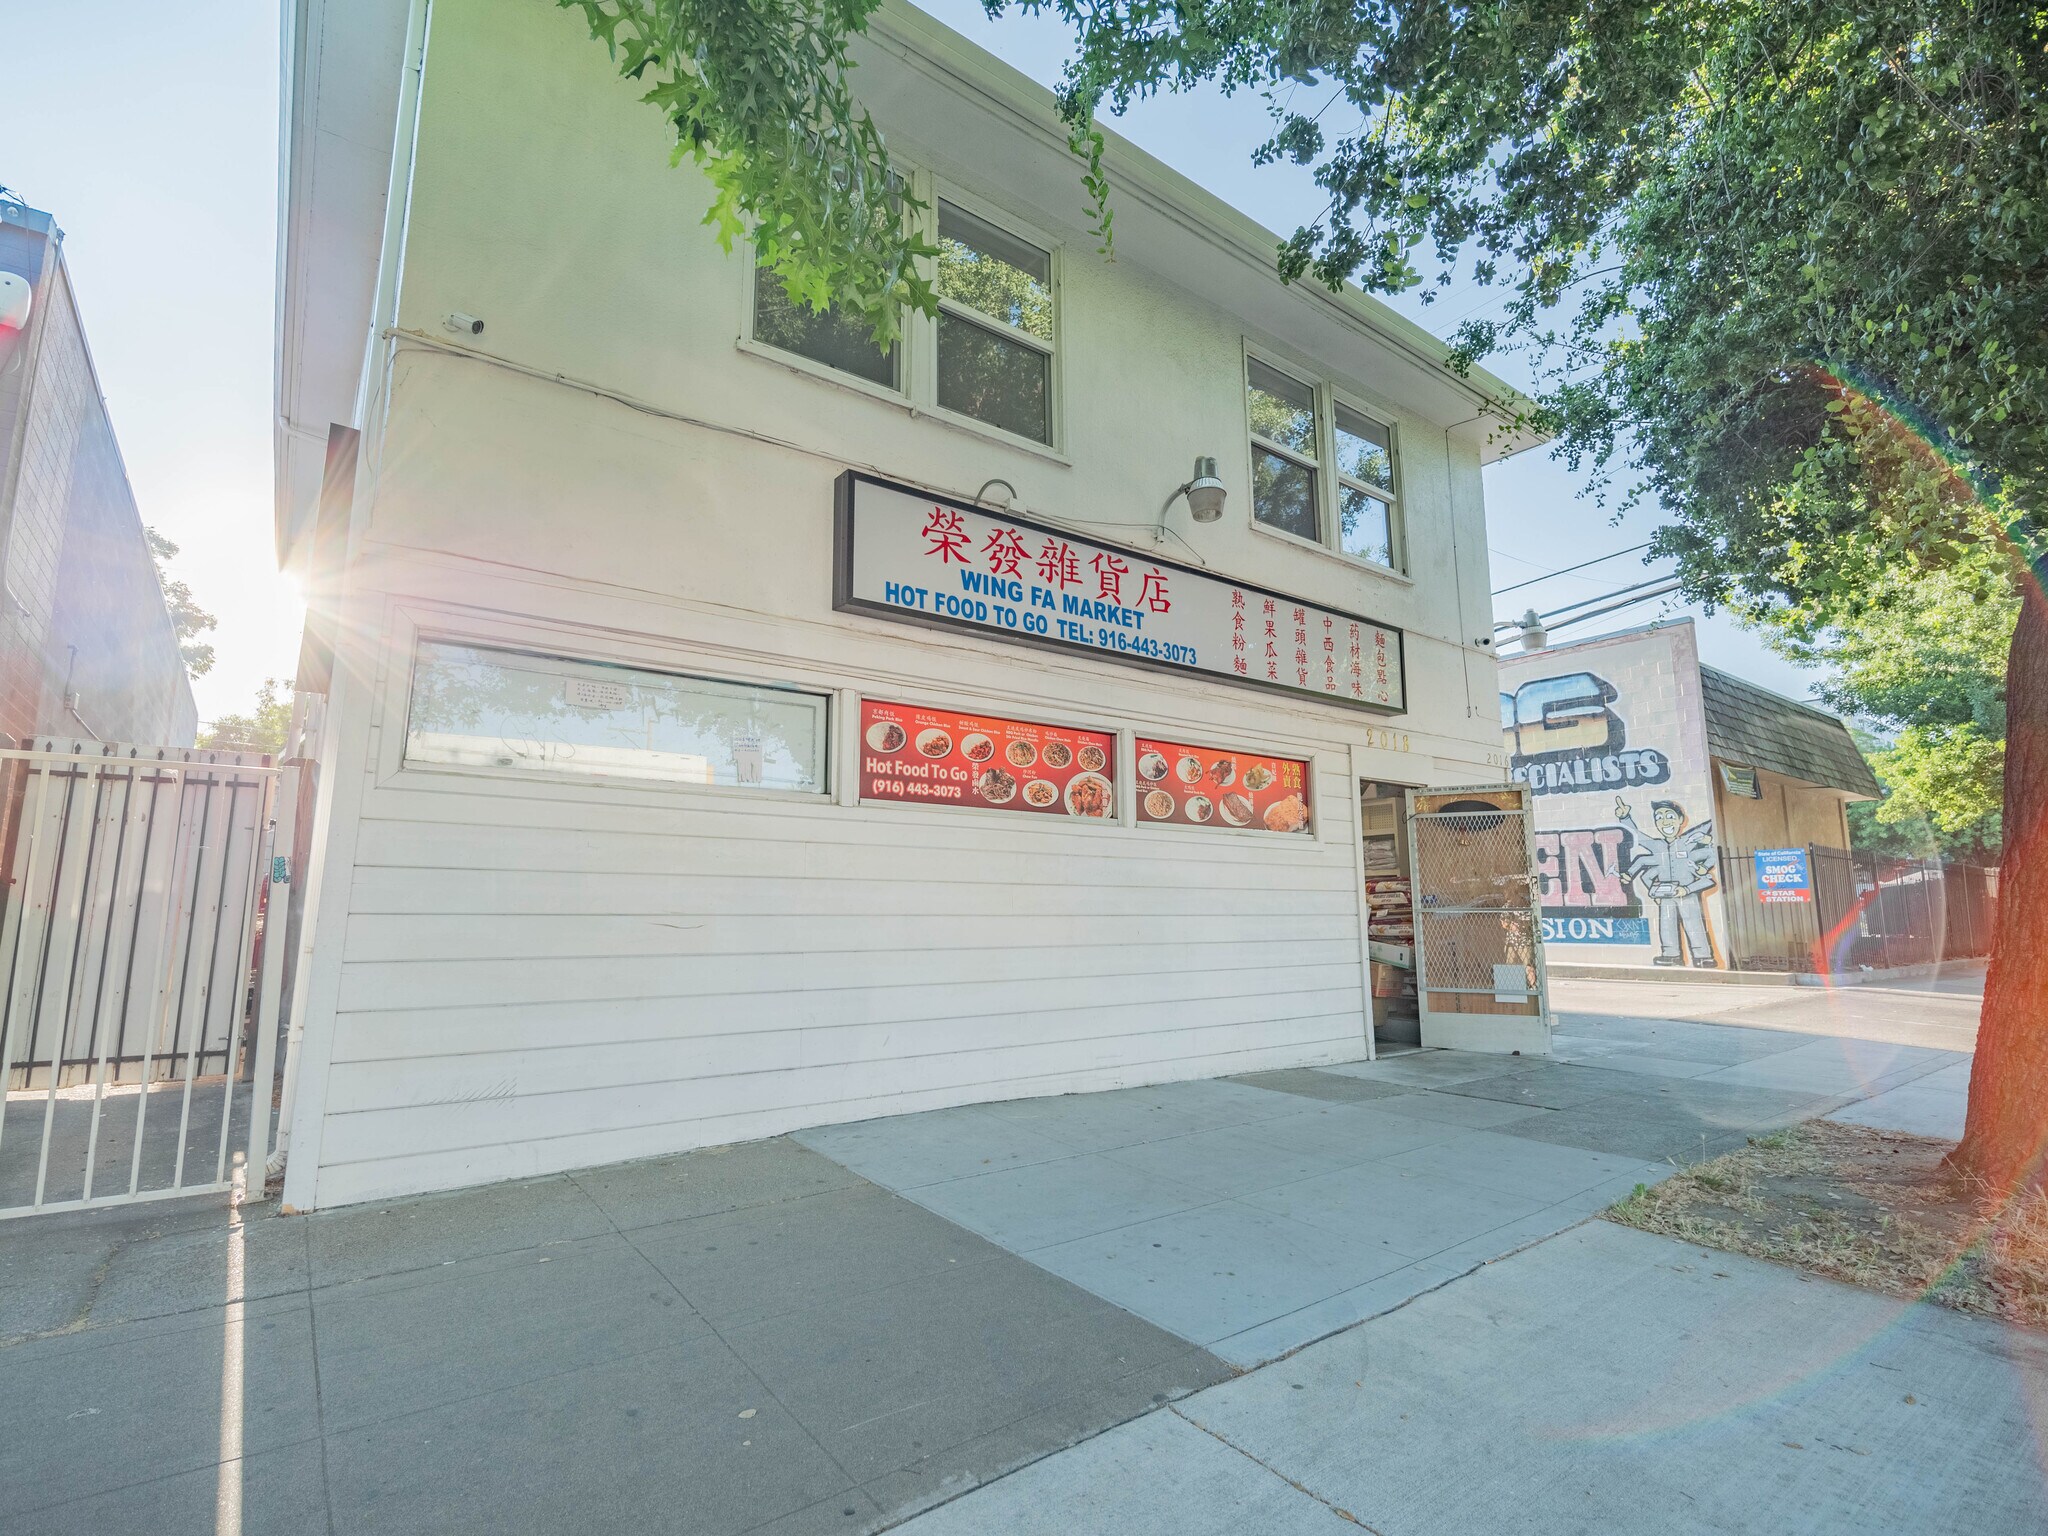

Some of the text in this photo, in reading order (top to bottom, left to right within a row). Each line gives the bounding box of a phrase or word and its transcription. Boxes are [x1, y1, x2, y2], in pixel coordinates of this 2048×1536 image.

[921, 506, 1171, 614] 榮發雜貨店
[885, 581, 1197, 665] HOT FOOD TO GO TEL: 916-443-3073
[960, 569, 1145, 630] WING FA MARKET
[1232, 589, 1248, 675] 熟食粉麵
[1263, 598, 1278, 680] 鮮果瓜菜
[1293, 608, 1308, 686] 罐頭雜貨
[1323, 616, 1336, 691] 中西食品
[1366, 728, 1410, 753] 2018
[1486, 753, 1509, 767] 2016
[866, 757, 968, 781] Hot Food To Go
[873, 780, 961, 797] (916) 443-3073
[1511, 751, 1660, 789] ECIALISTS
[1535, 829, 1628, 907] EN
[1761, 873, 1803, 883] CHECK
[1766, 865, 1796, 874] SMOG
[1542, 917, 1614, 940] SION
